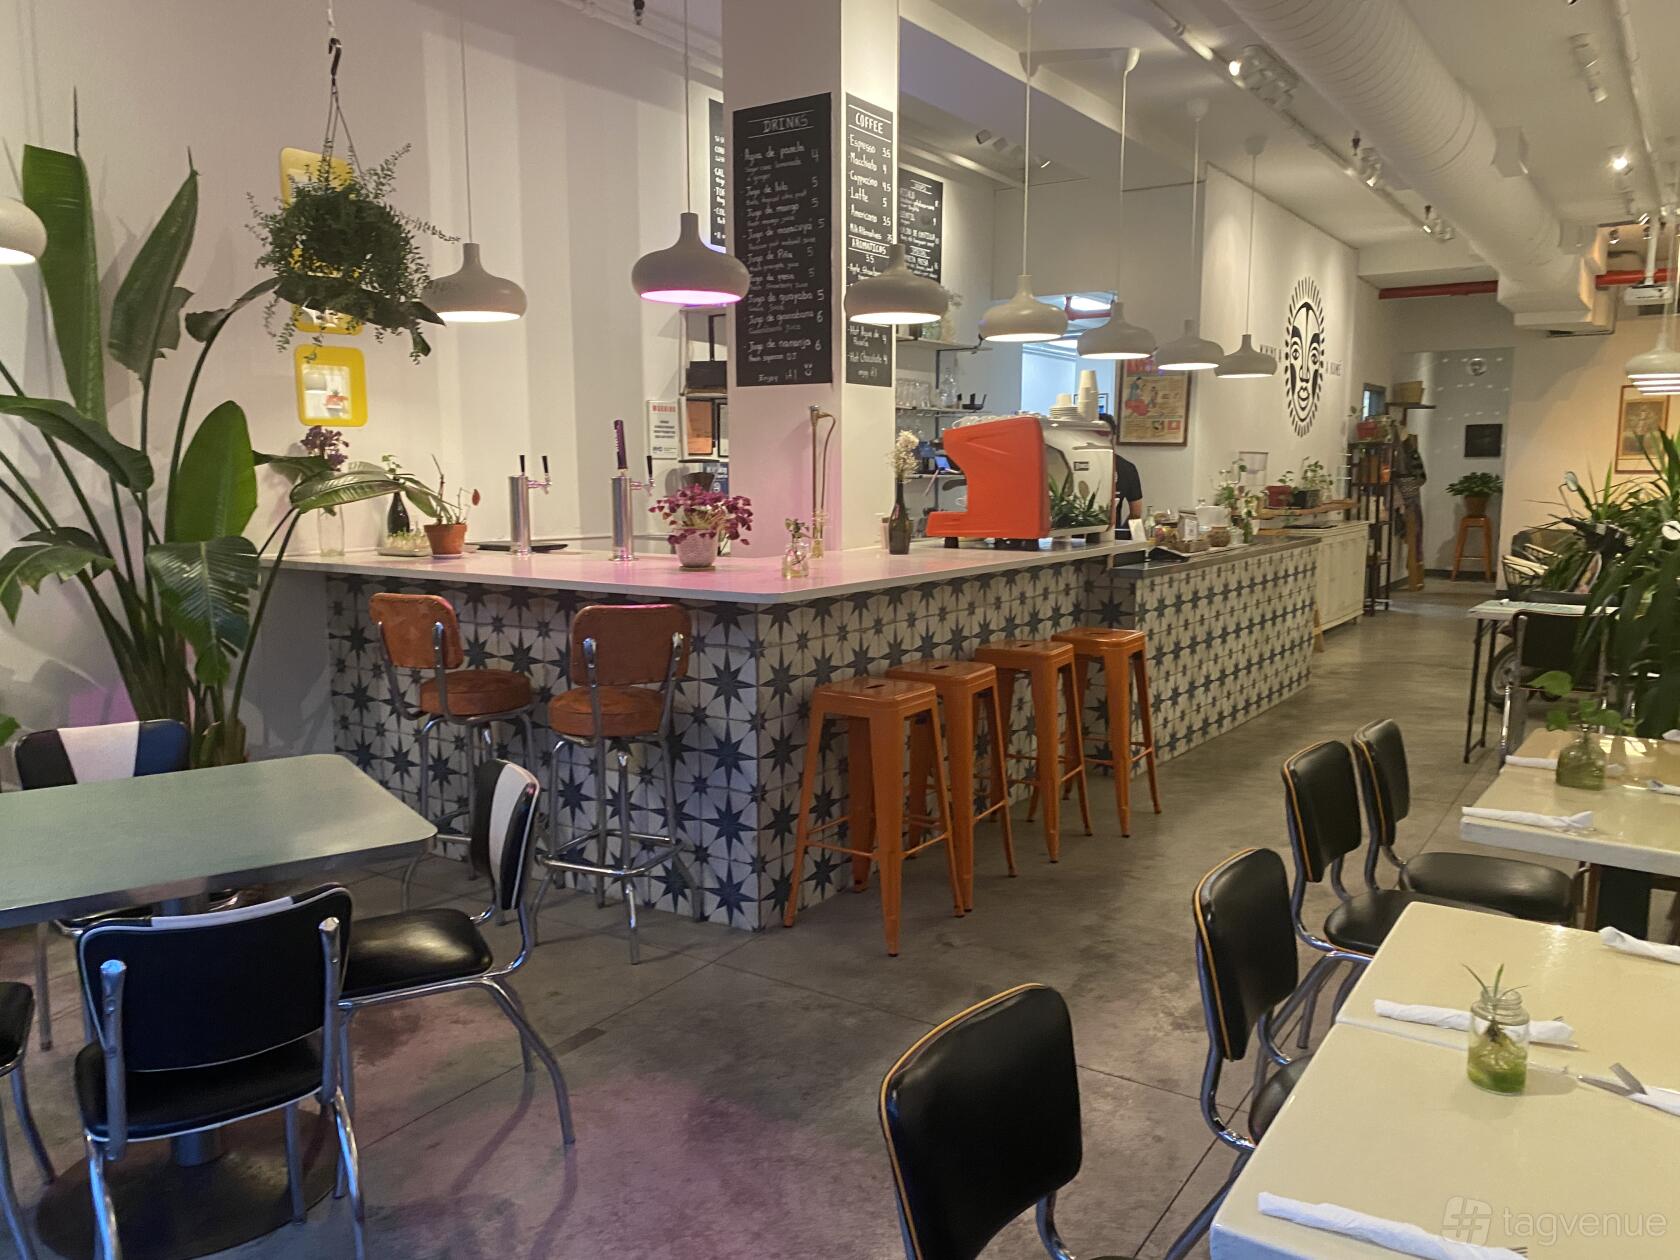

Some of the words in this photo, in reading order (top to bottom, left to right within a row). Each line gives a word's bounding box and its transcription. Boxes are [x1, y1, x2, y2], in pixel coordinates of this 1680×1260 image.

[762, 115, 809, 132] DRINKS
[856, 112, 883, 134] COFFEE
[850, 134, 876, 153] Espresso
[850, 187, 869, 202] Latte
[882, 198, 887, 208] 5
[817, 289, 824, 300] 5
[817, 311, 824, 323] 6
[815, 340, 822, 350] 6
